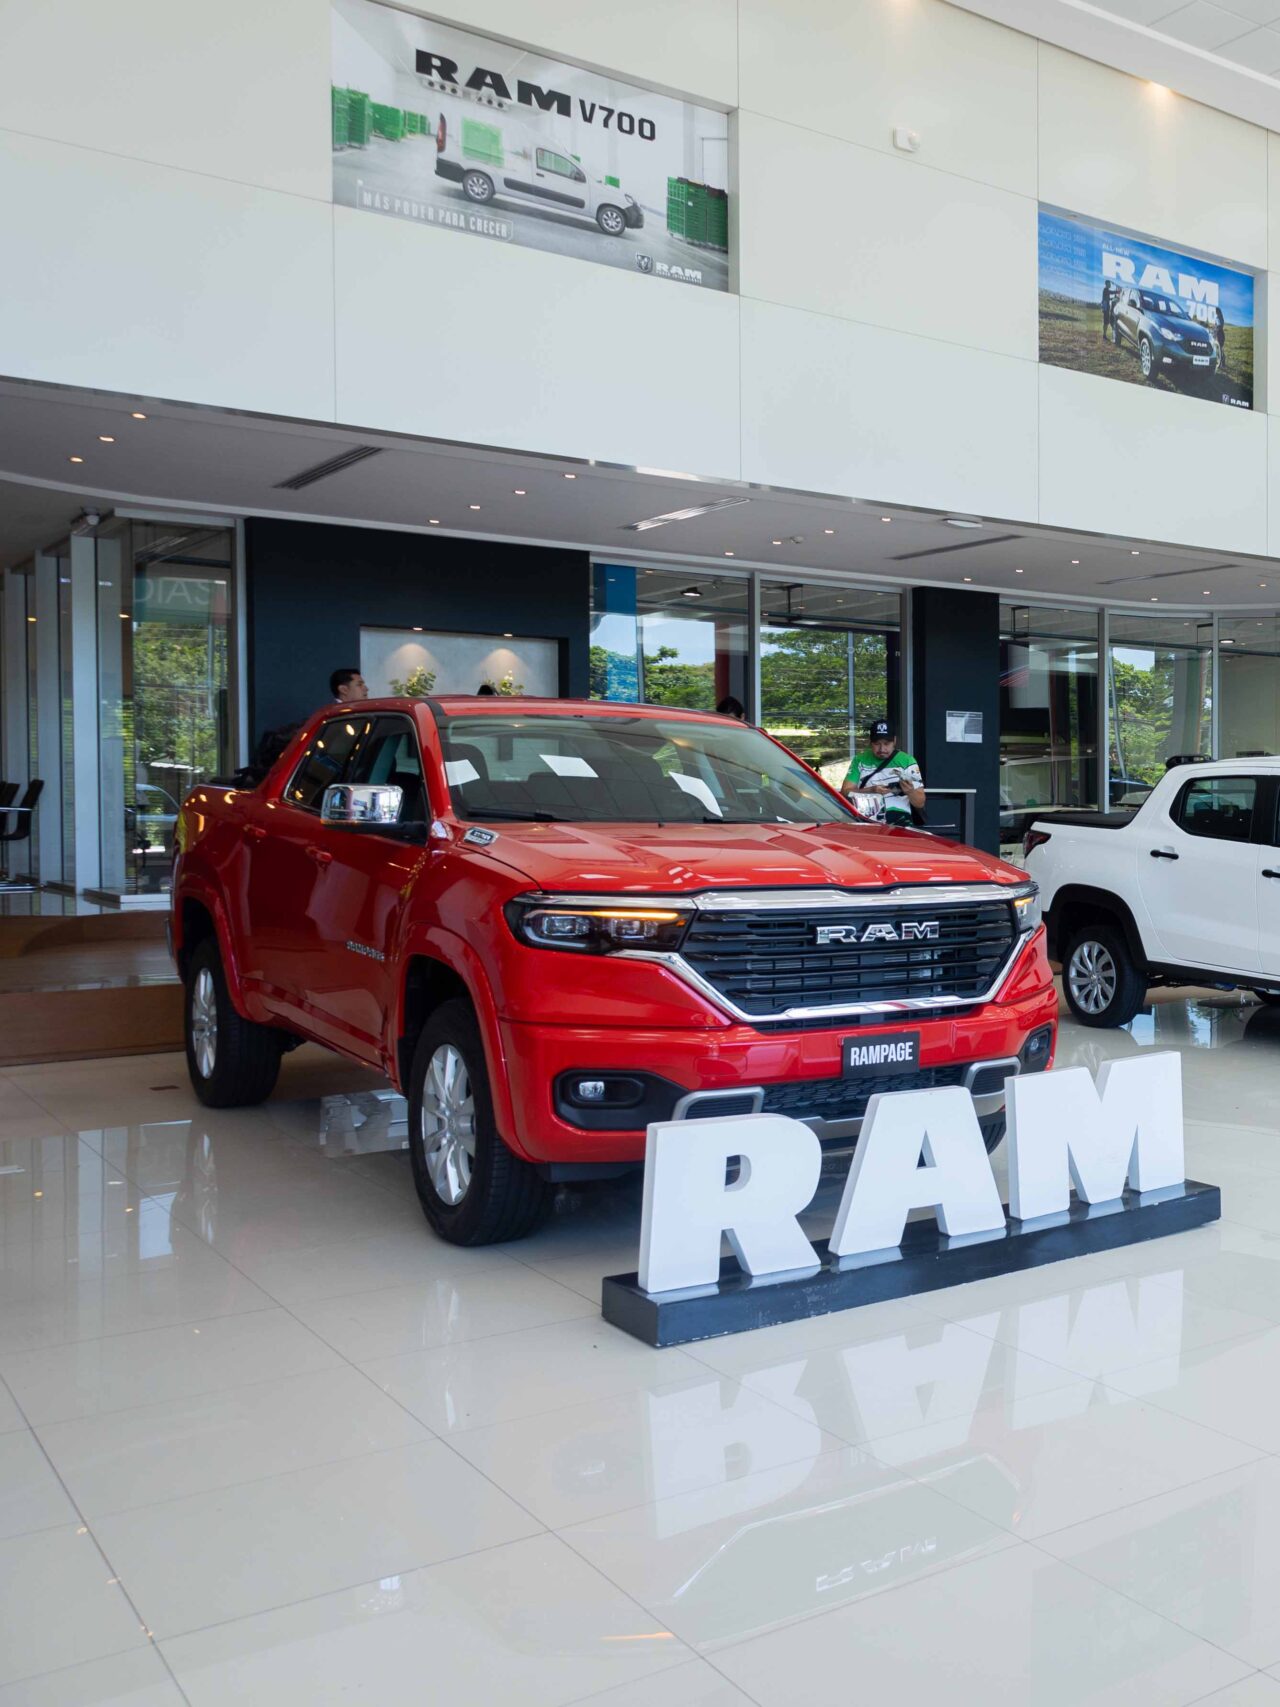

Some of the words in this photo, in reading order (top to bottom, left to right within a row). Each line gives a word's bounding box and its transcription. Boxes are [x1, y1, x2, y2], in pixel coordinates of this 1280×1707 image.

[415, 49, 571, 118] RAM
[578, 98, 656, 141] V700
[395, 200, 434, 220] PODER
[438, 208, 466, 228] PARA
[469, 216, 508, 237] CRECER
[655, 261, 702, 281] RAM
[1102, 251, 1219, 306] RAM
[1186, 300, 1218, 324] 700
[1230, 398, 1250, 408] RAM
[816, 921, 940, 945] RAM
[850, 1041, 913, 1066] RAMPAGE
[638, 1050, 1186, 1293] RAM
